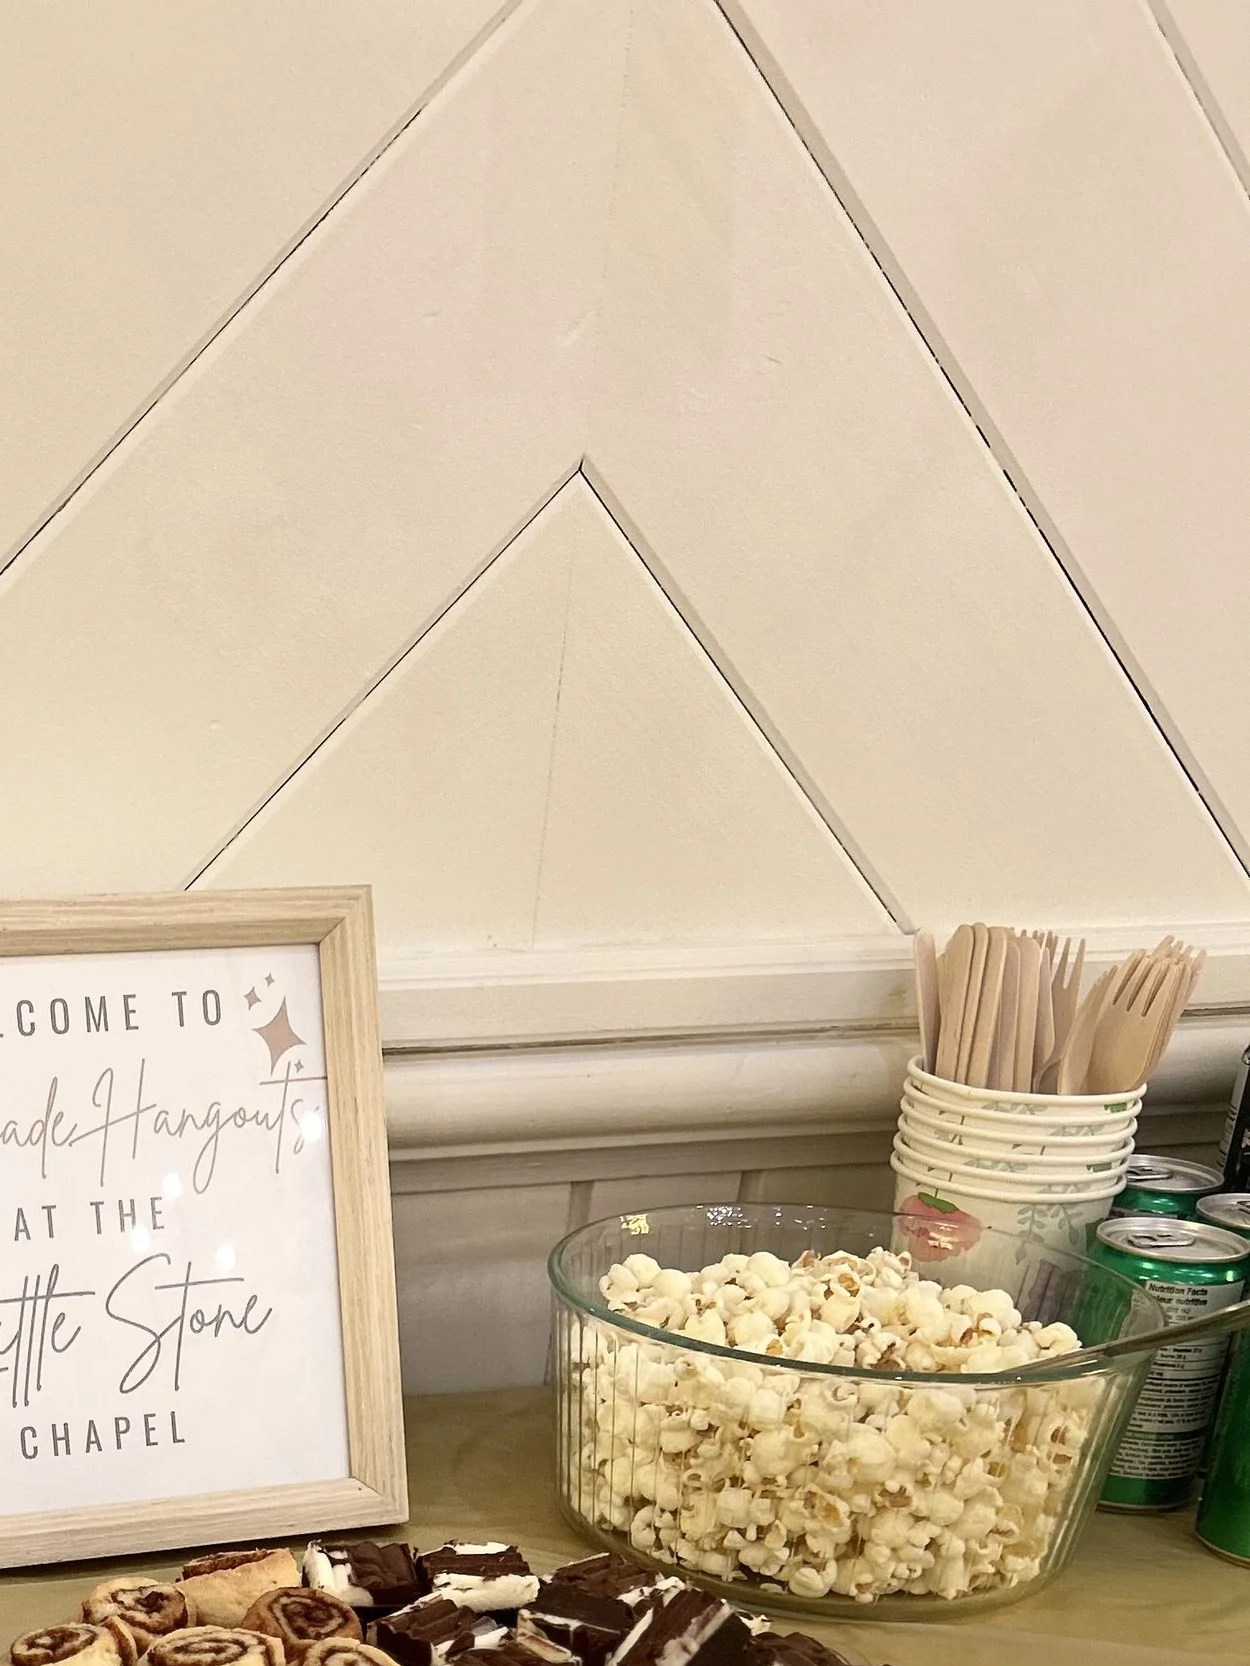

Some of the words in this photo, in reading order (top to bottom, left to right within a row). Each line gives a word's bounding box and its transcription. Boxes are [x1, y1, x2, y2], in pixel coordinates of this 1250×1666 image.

[171, 989, 222, 1028] TO
[68, 1058, 327, 1195] Hangouts
[13, 1204, 57, 1242] AT
[89, 1196, 165, 1235] THE
[1149, 1283, 1185, 1295] Nutrition
[1186, 1287, 1208, 1296] Facts
[105, 1252, 273, 1395] Stone
[19, 1410, 186, 1460] CHAPEL
